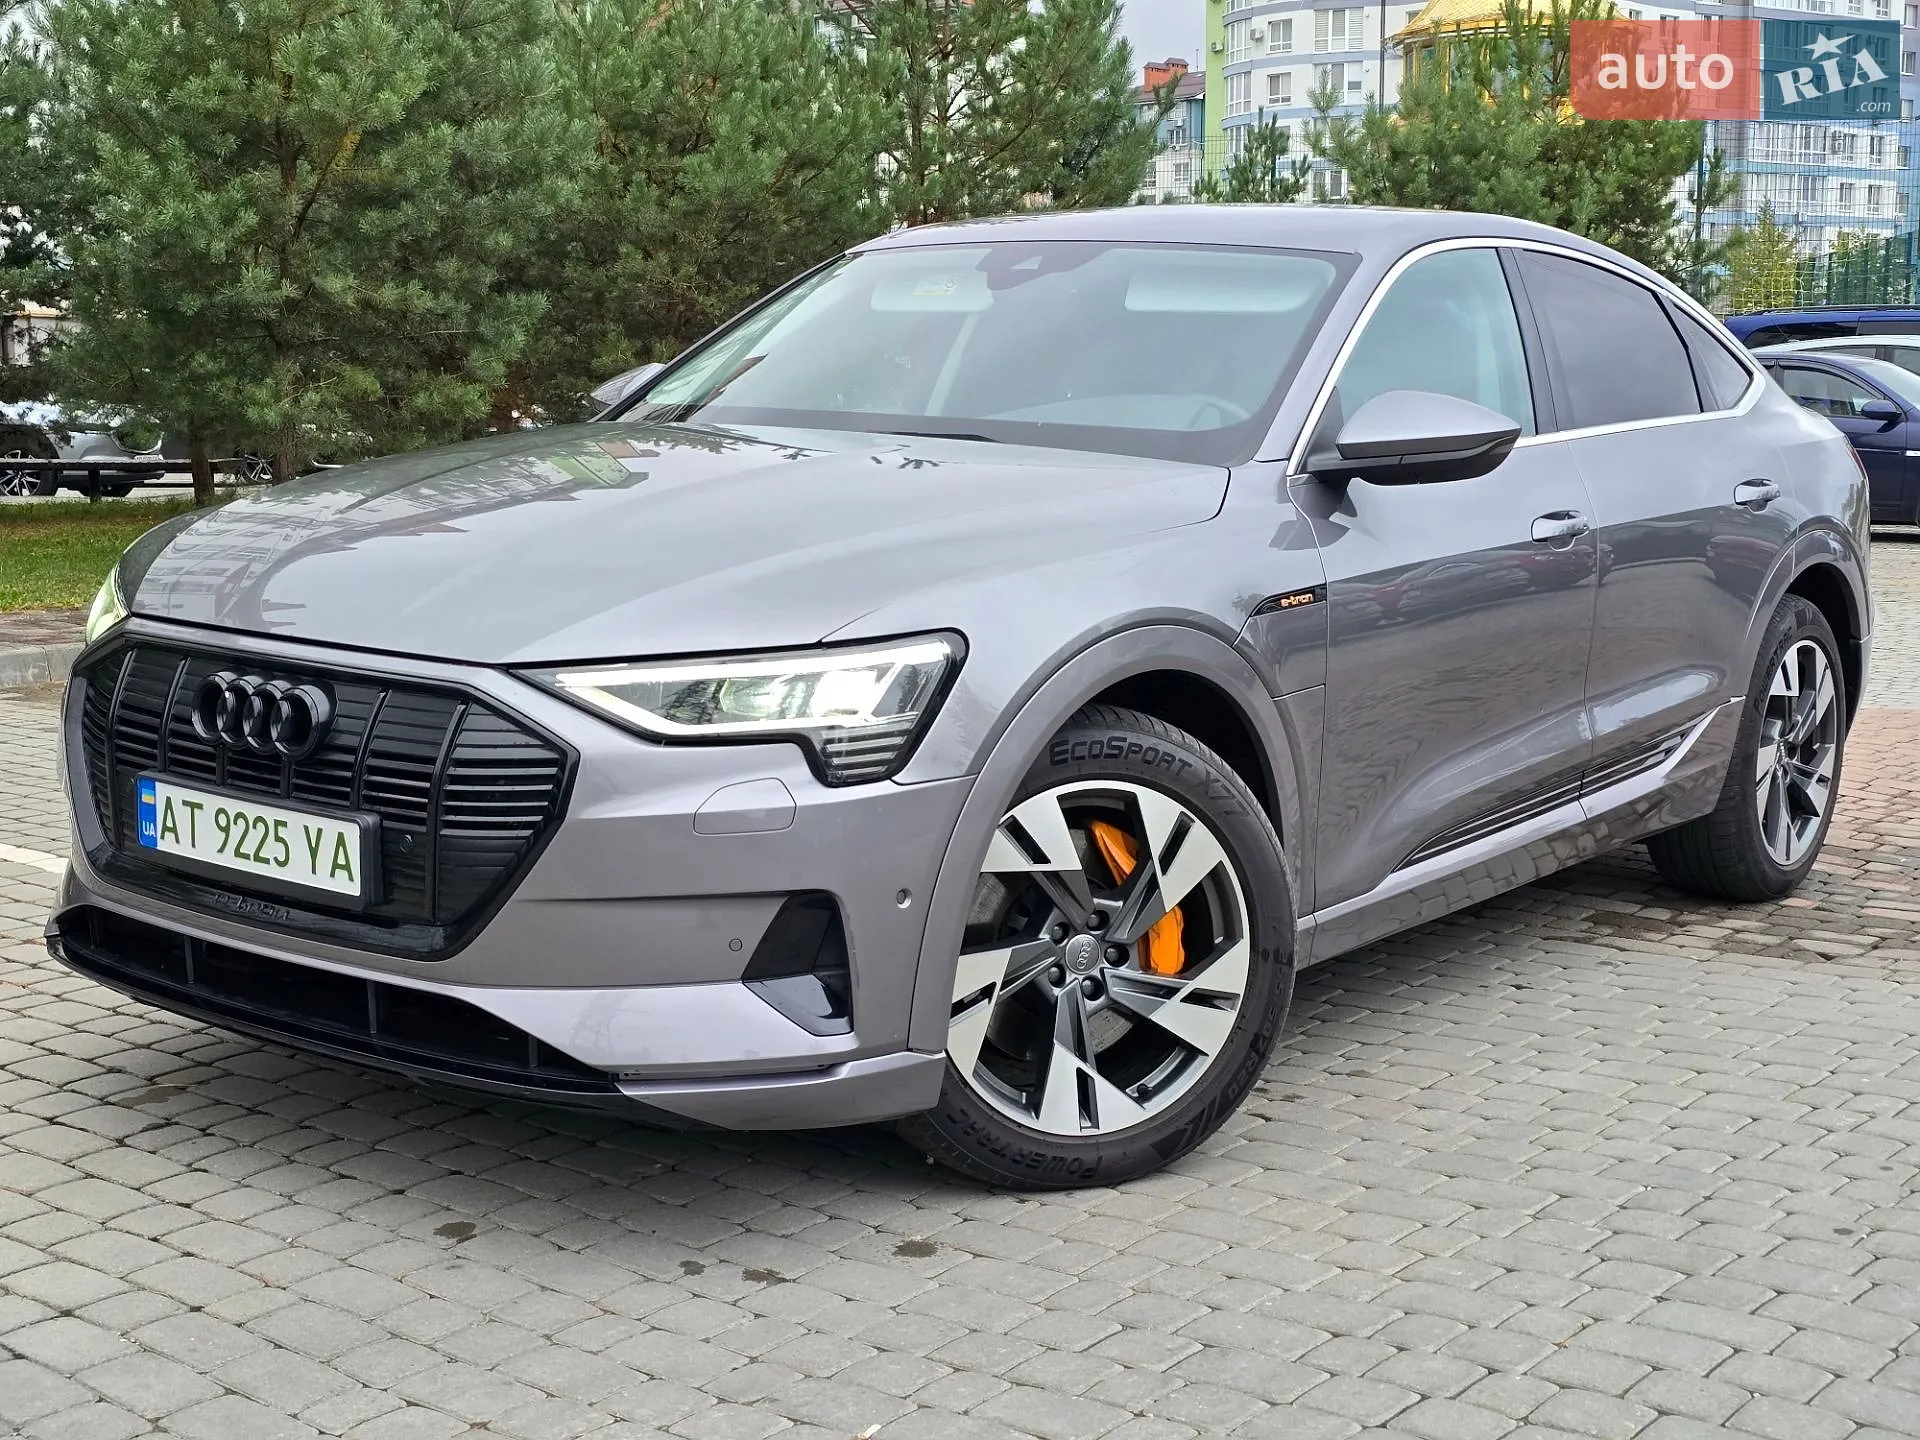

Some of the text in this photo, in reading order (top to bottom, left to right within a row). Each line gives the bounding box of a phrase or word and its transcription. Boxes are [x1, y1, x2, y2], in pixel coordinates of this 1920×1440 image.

[1281, 593, 1313, 607] e-tron
[143, 823, 156, 838] UA
[160, 796, 354, 882] AT 9225 YA
